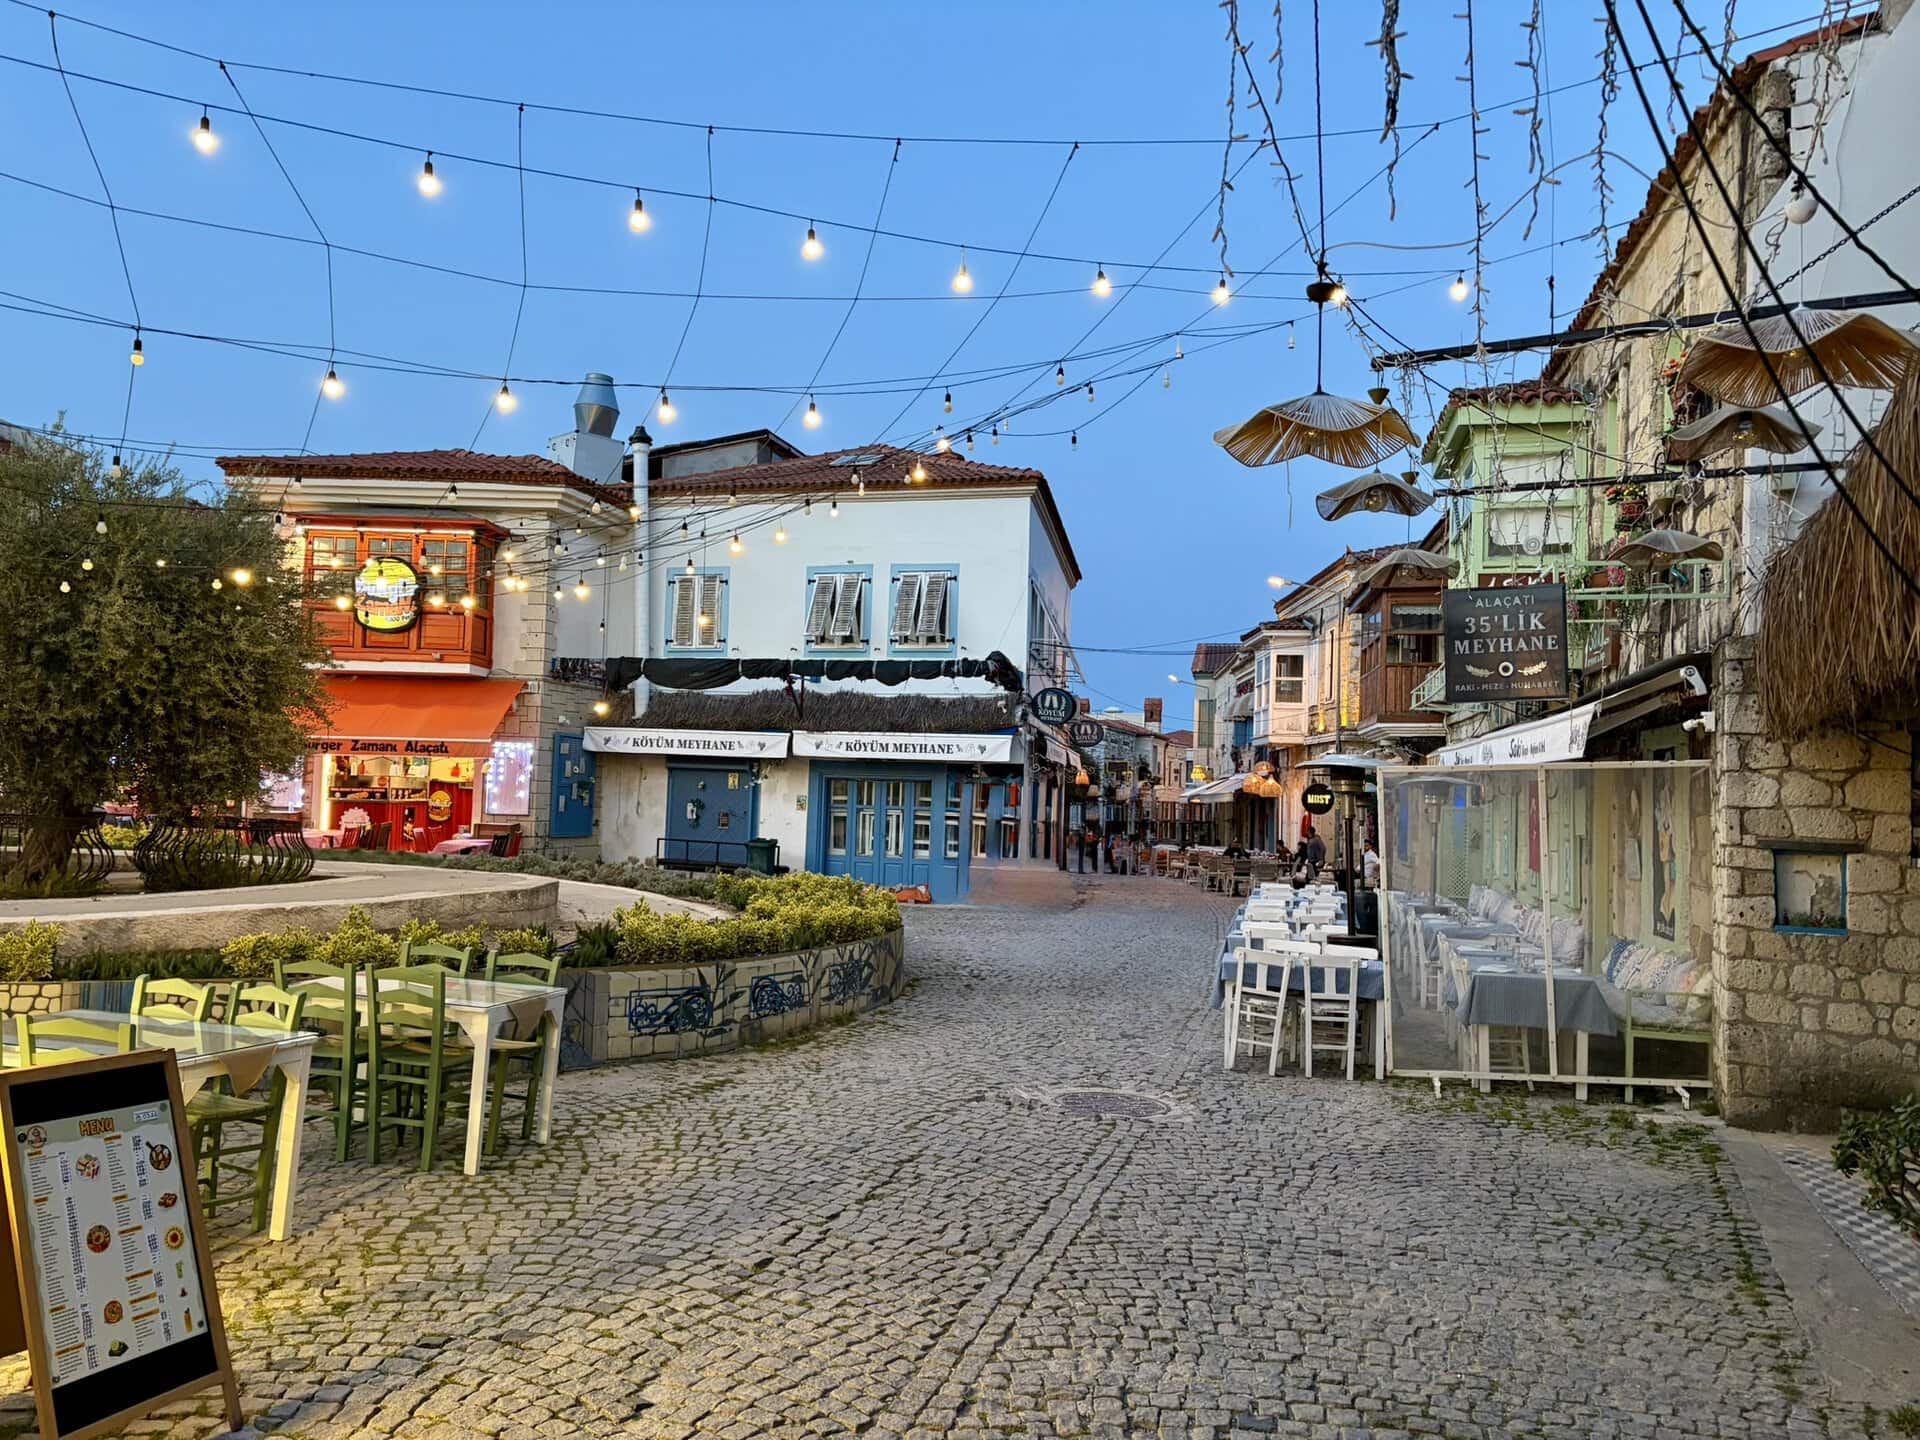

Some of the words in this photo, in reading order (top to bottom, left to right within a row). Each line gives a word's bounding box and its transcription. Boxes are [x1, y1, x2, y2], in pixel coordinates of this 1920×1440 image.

[1475, 595, 1535, 608] ALAÇATI
[1465, 609, 1546, 634] 35'LİK
[1454, 635, 1559, 655] MEYHANE
[304, 741, 343, 753] urger
[350, 740, 397, 752] Zamanı
[404, 741, 449, 755] Alaçatı
[632, 736, 675, 749] KÖYÜM
[677, 738, 736, 751] MEYHANE
[846, 739, 890, 752] KÖYÜM
[892, 742, 954, 755] MEYHANE
[79, 1117, 115, 1136] MENU
